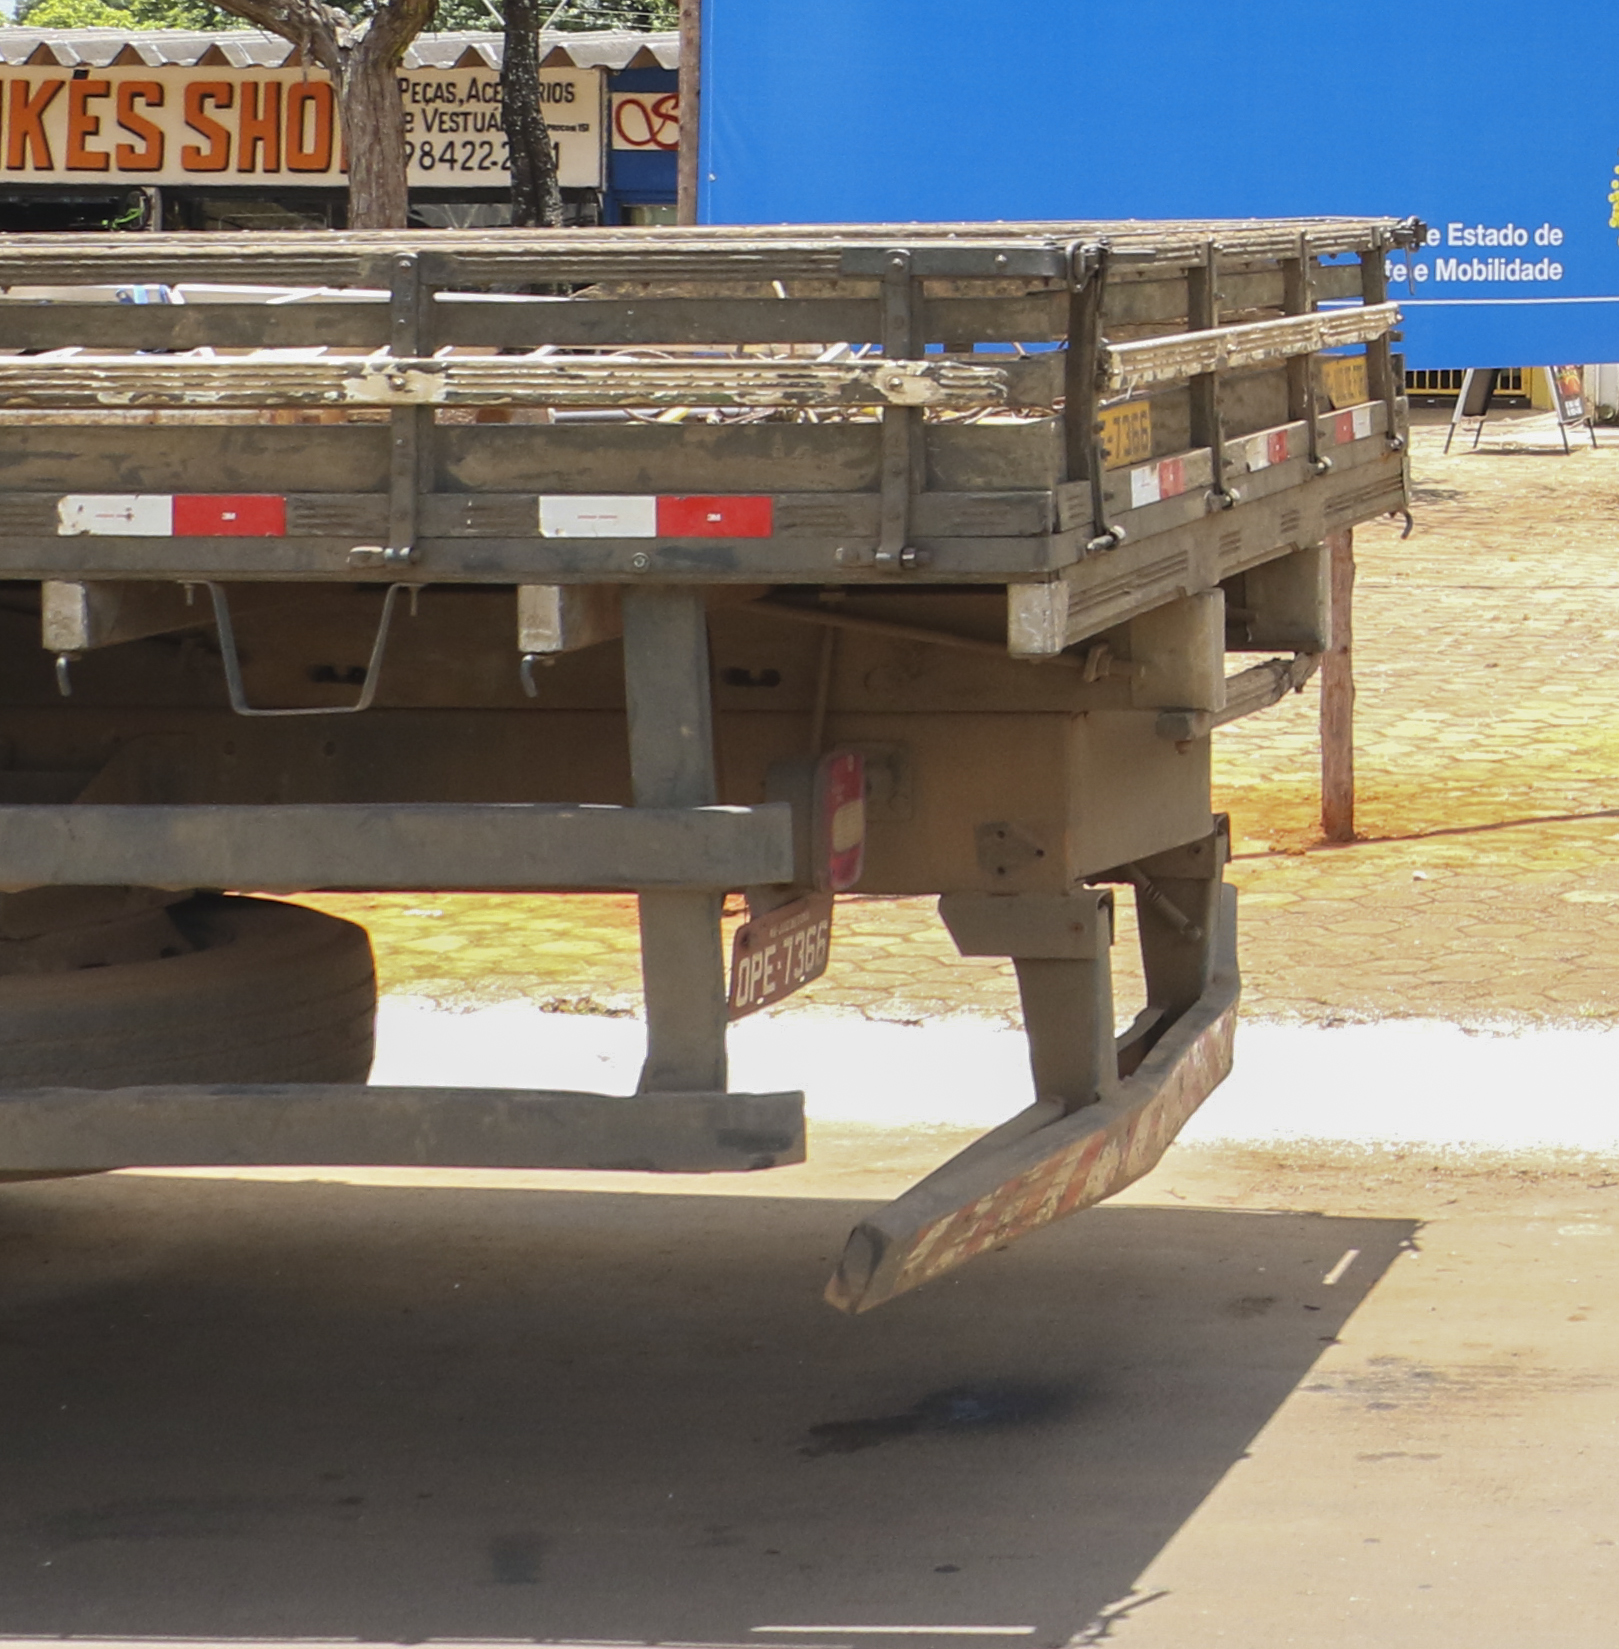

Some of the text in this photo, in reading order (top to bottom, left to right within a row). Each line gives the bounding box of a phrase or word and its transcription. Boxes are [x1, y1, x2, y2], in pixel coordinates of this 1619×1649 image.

[180, 80, 348, 174] SHO
[1447, 223, 1530, 247] Estado
[1534, 223, 1564, 247] de
[1435, 258, 1564, 283] Mobilidade
